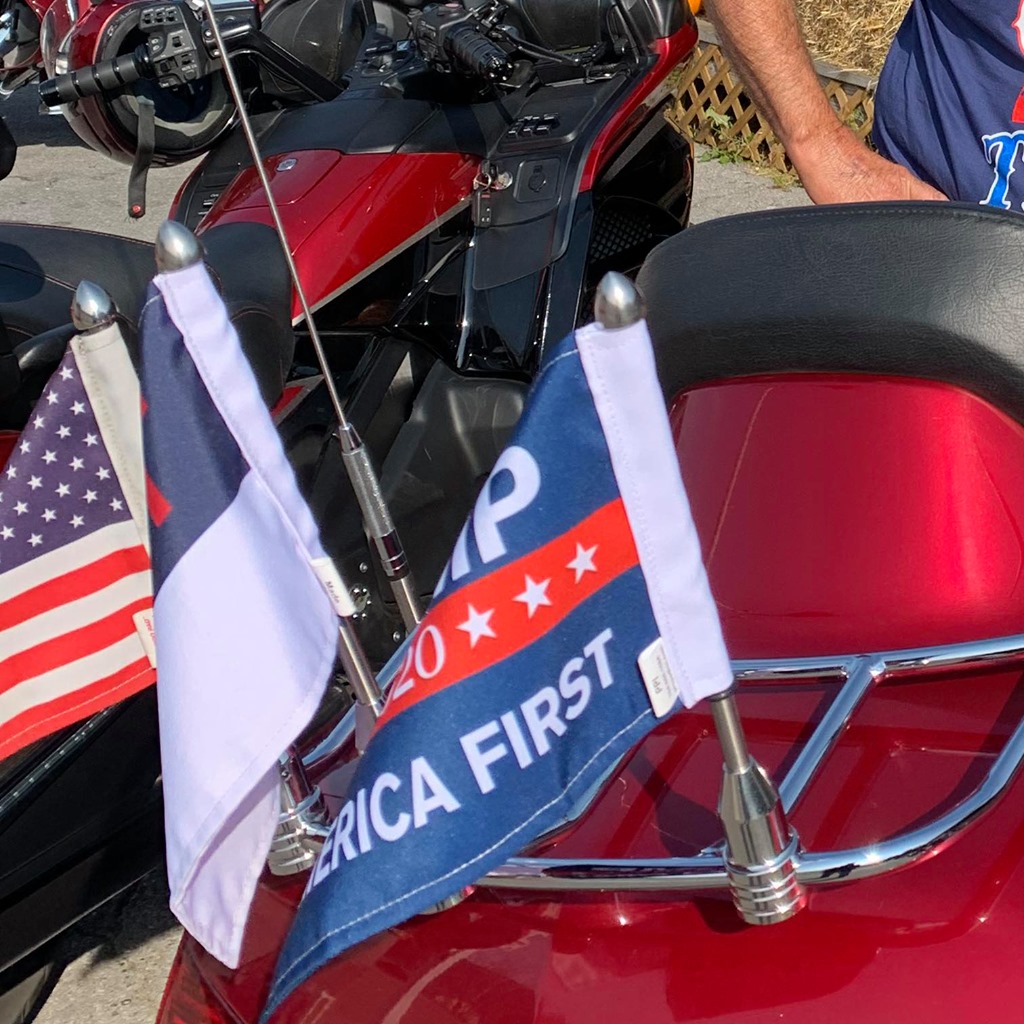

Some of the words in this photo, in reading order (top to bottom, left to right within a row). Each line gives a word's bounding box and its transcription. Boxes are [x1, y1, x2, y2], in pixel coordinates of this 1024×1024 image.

[388, 624, 447, 706] 20
[304, 755, 462, 895] ERICA
[460, 627, 614, 795] FIRST
